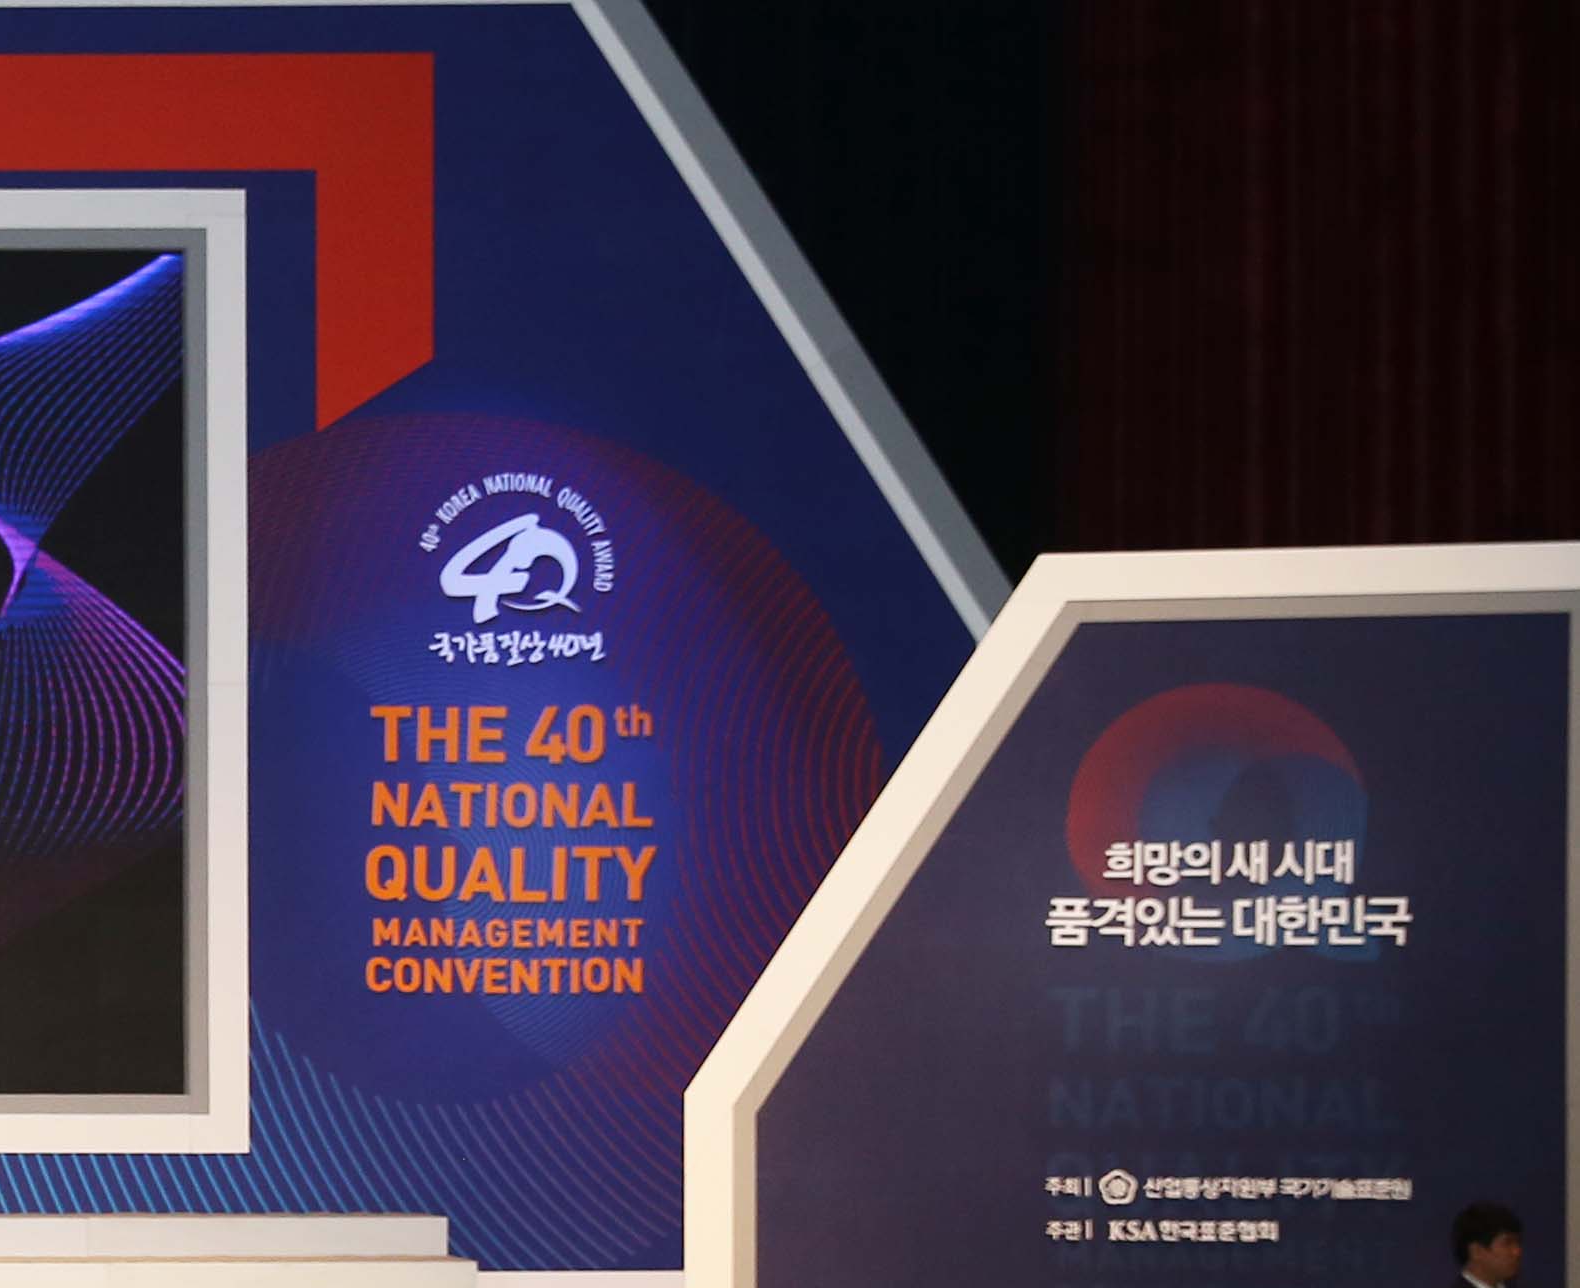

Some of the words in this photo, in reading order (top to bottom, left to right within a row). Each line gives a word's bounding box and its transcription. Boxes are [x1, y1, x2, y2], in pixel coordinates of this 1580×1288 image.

[436, 483, 482, 525] KOREA
[483, 472, 554, 498] NATIONAL
[557, 486, 606, 537] QUALITY
[591, 539, 615, 592] AWARD
[371, 706, 508, 763] THE
[527, 705, 653, 764] 40th
[372, 782, 653, 828] NATIONAL
[366, 845, 656, 902] QUALITY
[1103, 841, 1220, 885] 희망의
[1226, 841, 1268, 884] 새
[1274, 840, 1353, 884] 시대
[373, 918, 644, 948] MANAGEMENT
[1045, 896, 1225, 946] 품격있는
[1233, 896, 1412, 946] 대한민국
[366, 957, 644, 993] CONVENTION
[1108, 1219, 1158, 1242] KSA
